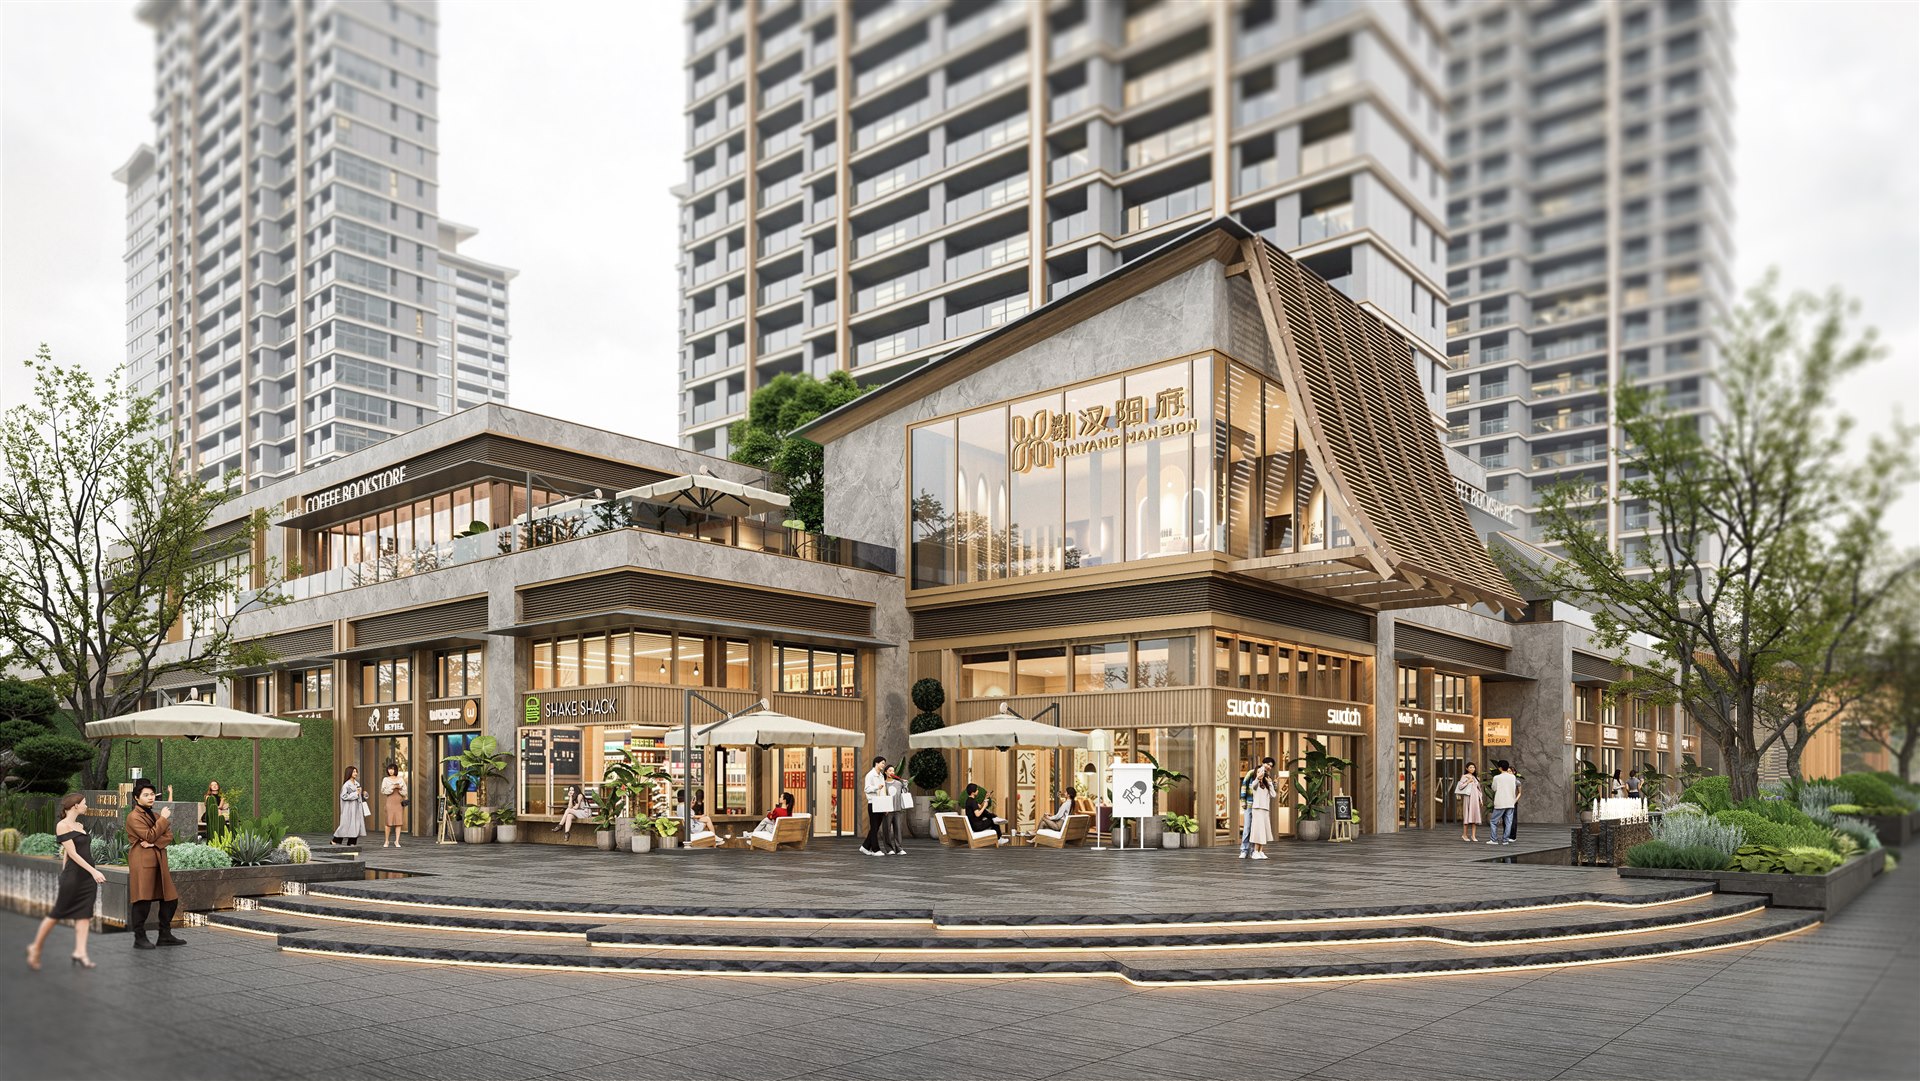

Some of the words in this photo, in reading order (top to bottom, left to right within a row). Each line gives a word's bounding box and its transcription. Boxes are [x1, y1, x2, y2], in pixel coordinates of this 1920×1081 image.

[1078, 386, 1189, 437] 汉阳府
[1053, 434, 1119, 459] HANYANG
[1125, 418, 1198, 444] MANSION
[305, 487, 341, 514] COFFEE
[342, 465, 407, 502] BOOKSTORE
[545, 700, 578, 718] SHAKE
[580, 697, 617, 716] SHACK
[1413, 713, 1424, 726] Tea
